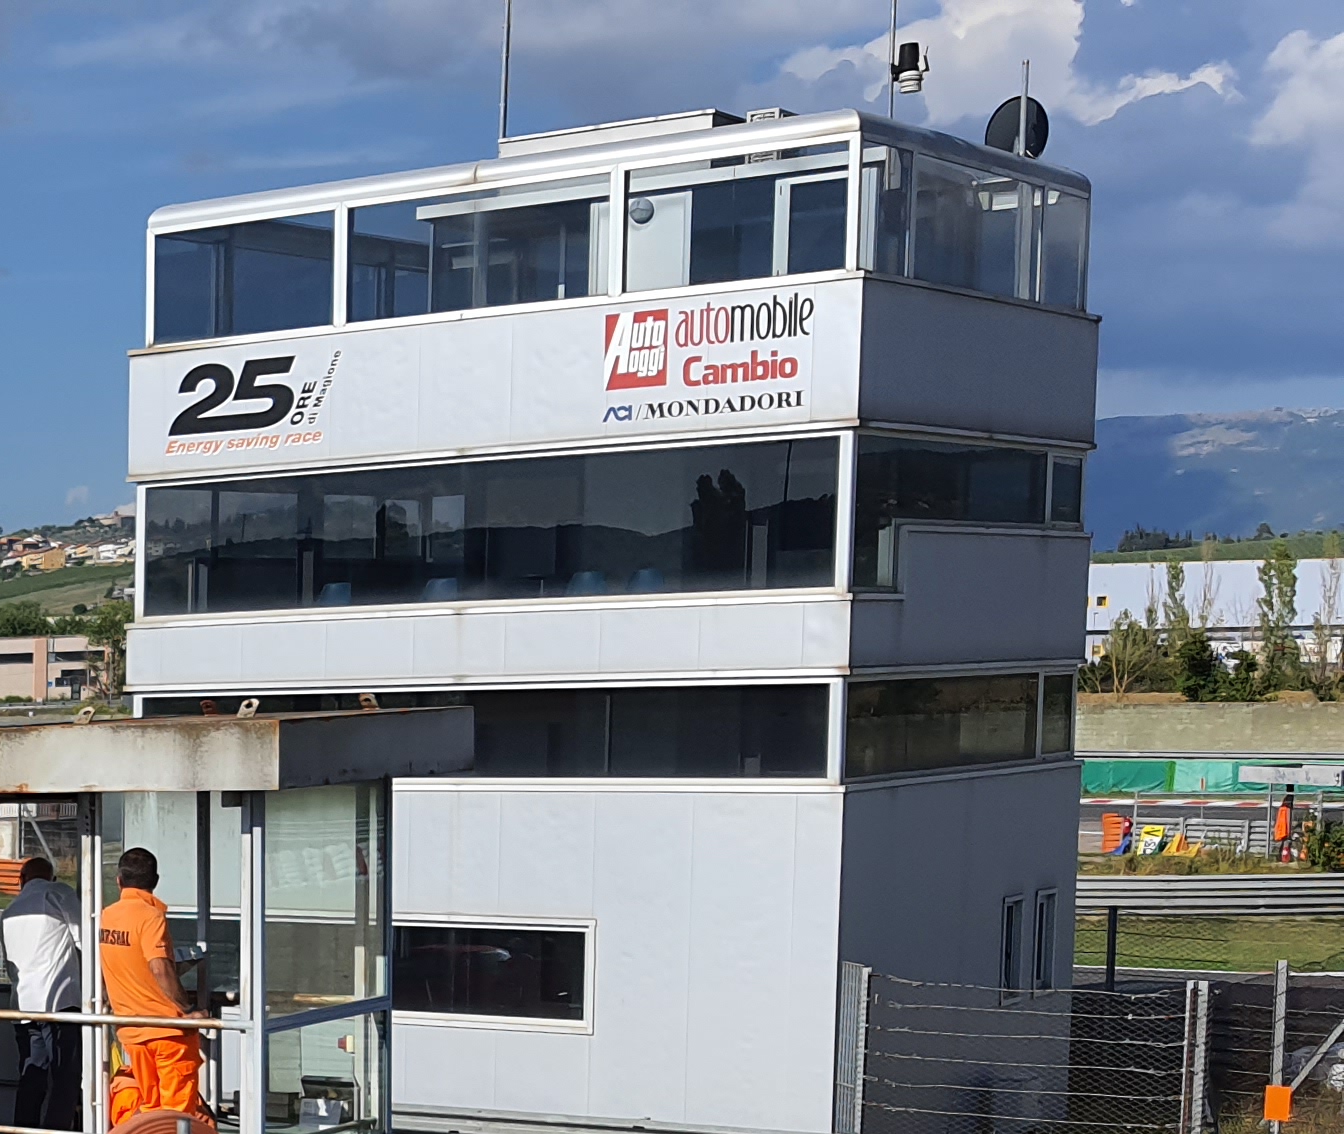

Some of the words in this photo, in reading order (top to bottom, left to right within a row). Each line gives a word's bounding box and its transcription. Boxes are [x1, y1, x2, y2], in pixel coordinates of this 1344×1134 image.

[675, 292, 815, 348] automobile
[313, 350, 342, 407] Magione
[627, 347, 665, 377] oggi
[683, 350, 799, 387] Cambio
[168, 355, 296, 437] 25
[290, 380, 318, 426] ORE
[165, 439, 224, 455] Energy
[226, 433, 282, 450] saving
[284, 431, 323, 444] race
